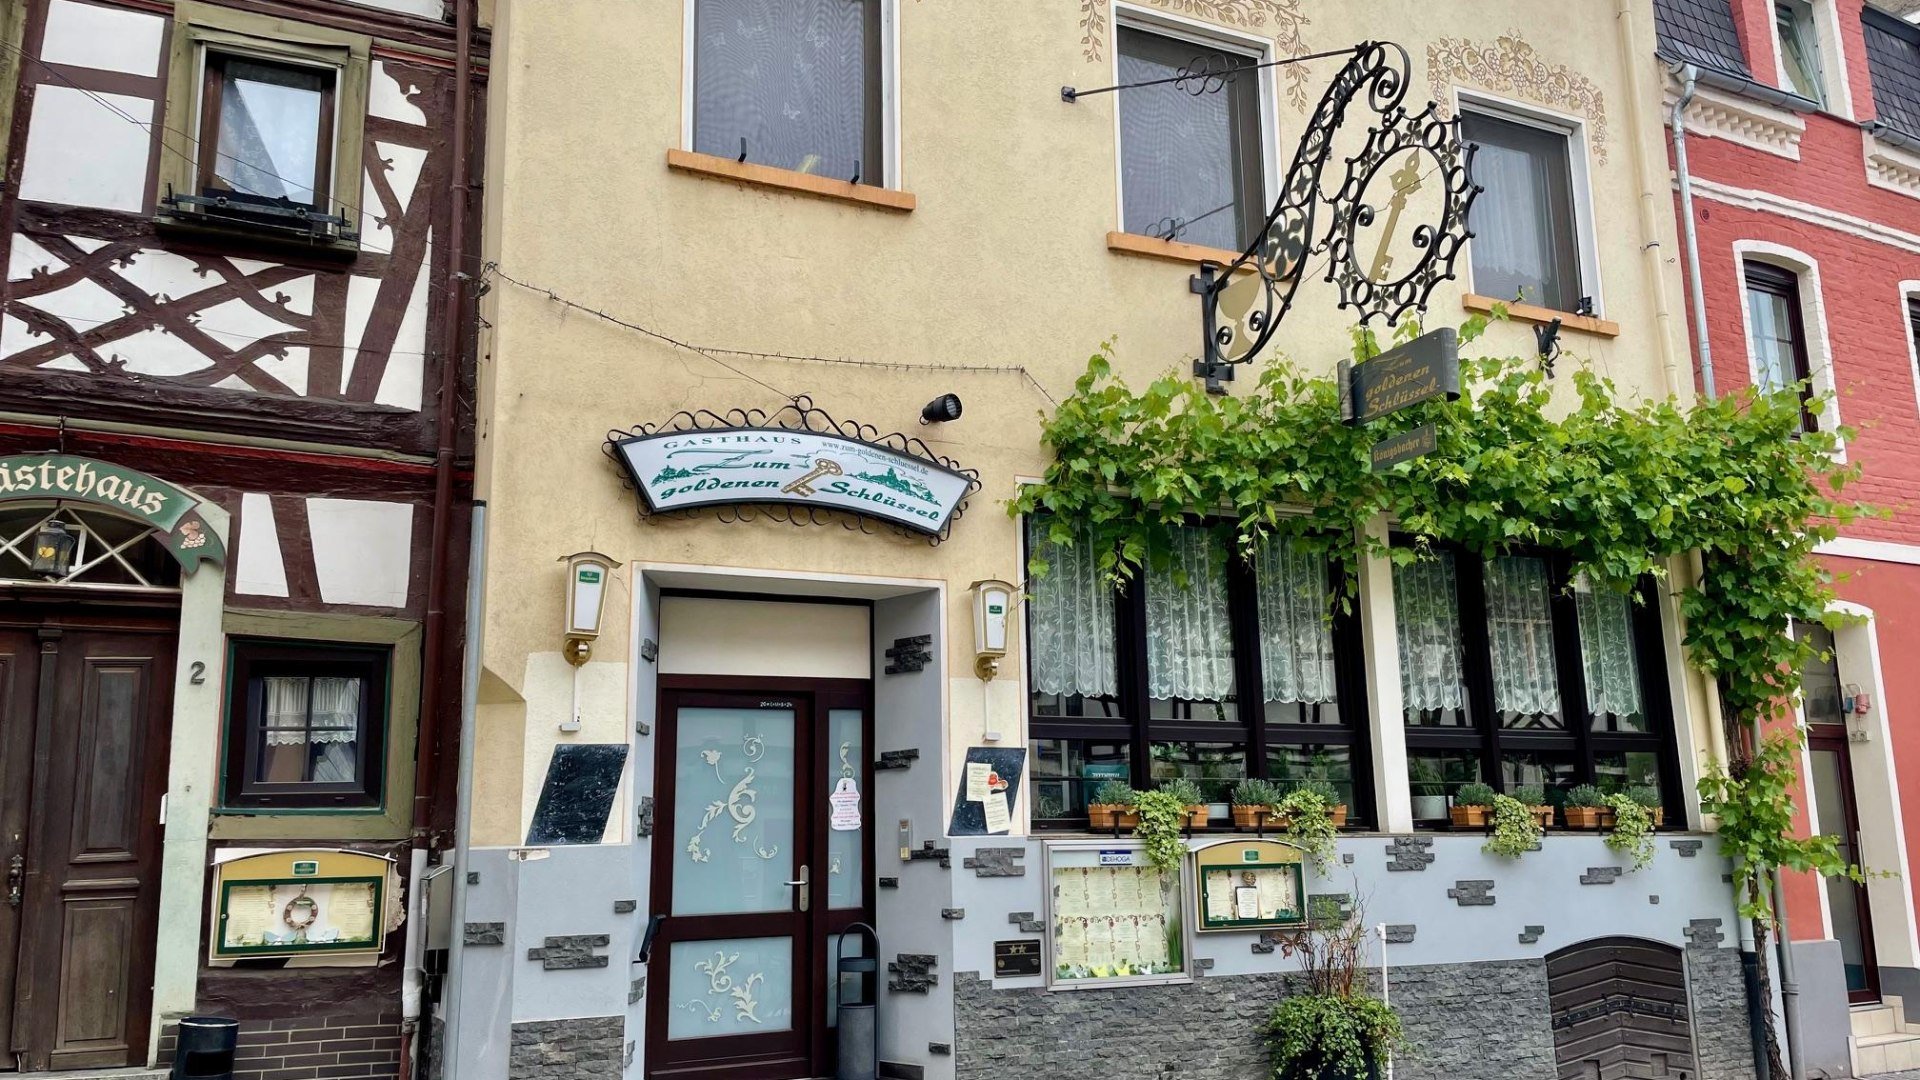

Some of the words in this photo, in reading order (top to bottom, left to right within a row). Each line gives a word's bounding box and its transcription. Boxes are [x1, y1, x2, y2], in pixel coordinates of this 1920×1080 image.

[1365, 365, 1430, 399] goldenen
[1363, 377, 1438, 418] Schlüssel
[663, 435, 802, 449] GASTHAUS
[666, 448, 792, 471] Zum
[822, 441, 930, 475] www.zum-goldenen-schluessel.de
[660, 477, 780, 500] goldenen
[820, 481, 939, 521] Schlüssel
[190, 661, 206, 685] 2
